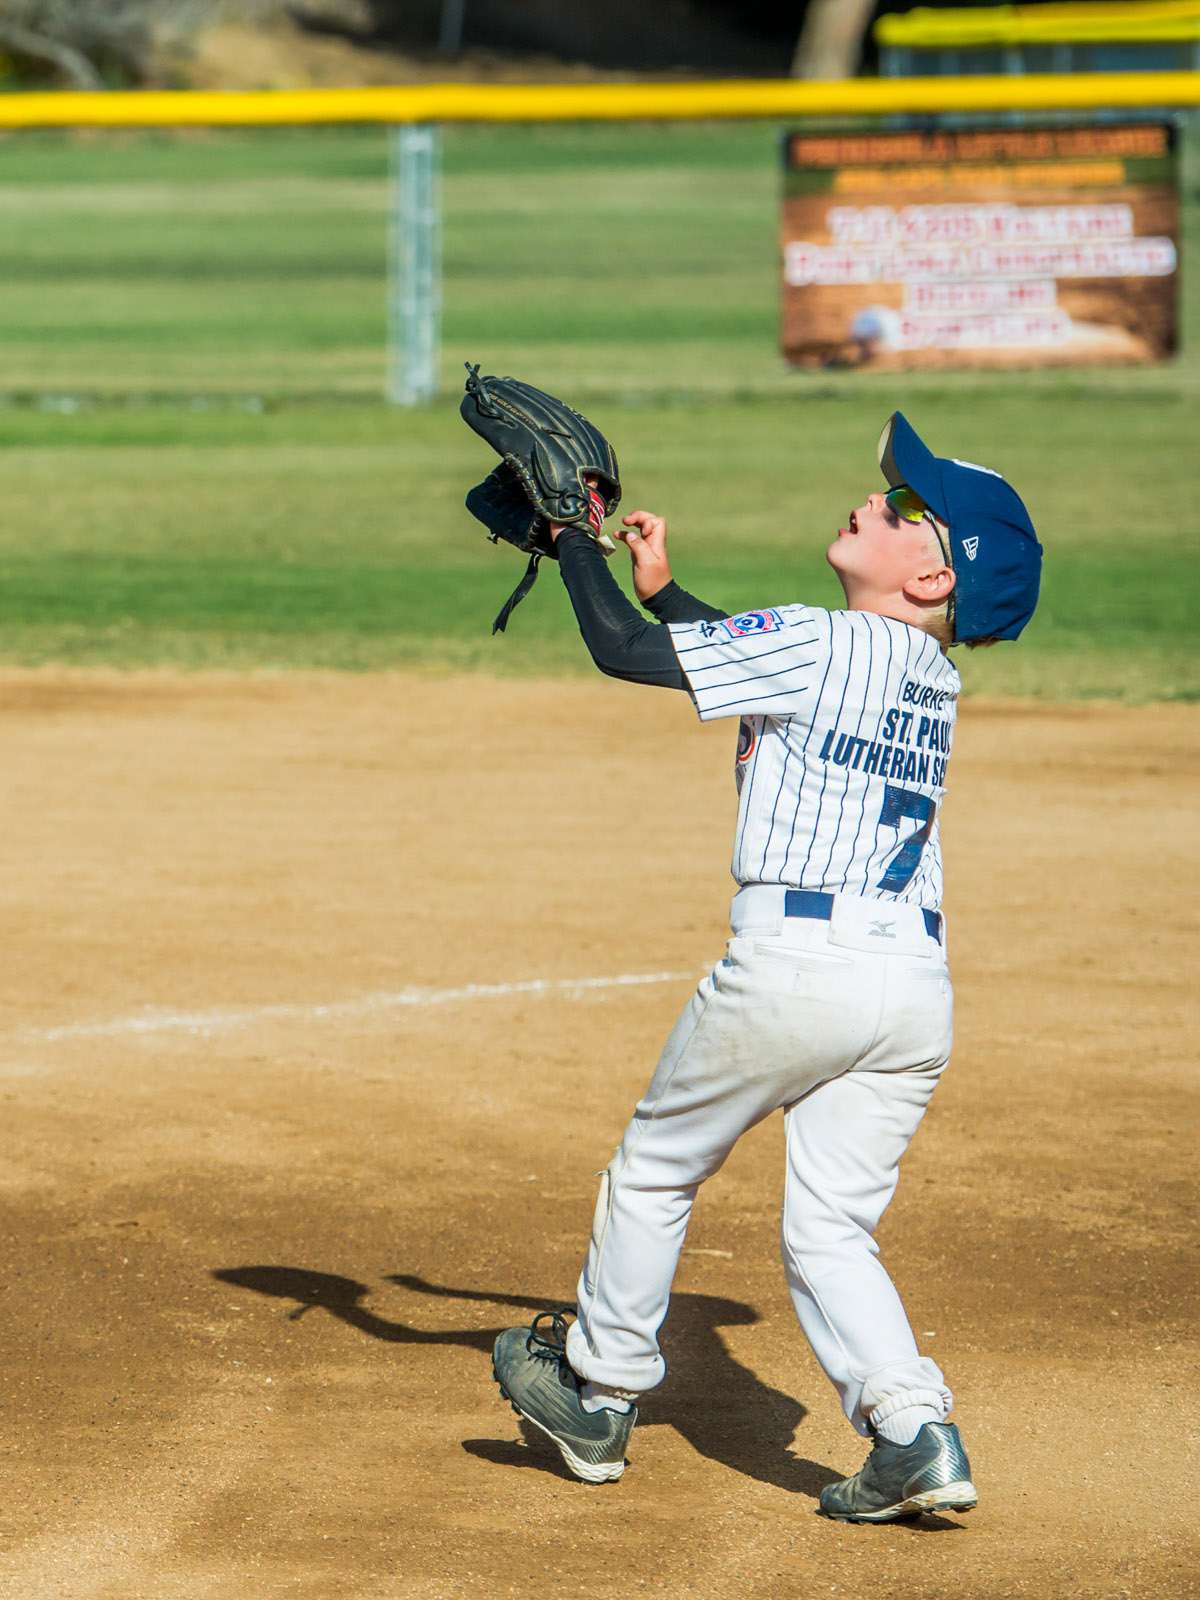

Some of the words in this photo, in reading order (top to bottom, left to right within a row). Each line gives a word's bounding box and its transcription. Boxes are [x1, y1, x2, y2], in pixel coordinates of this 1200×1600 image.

[882, 708, 914, 745] ST.
[818, 729, 930, 784] LUTHERAN
[876, 783, 937, 894] 7
